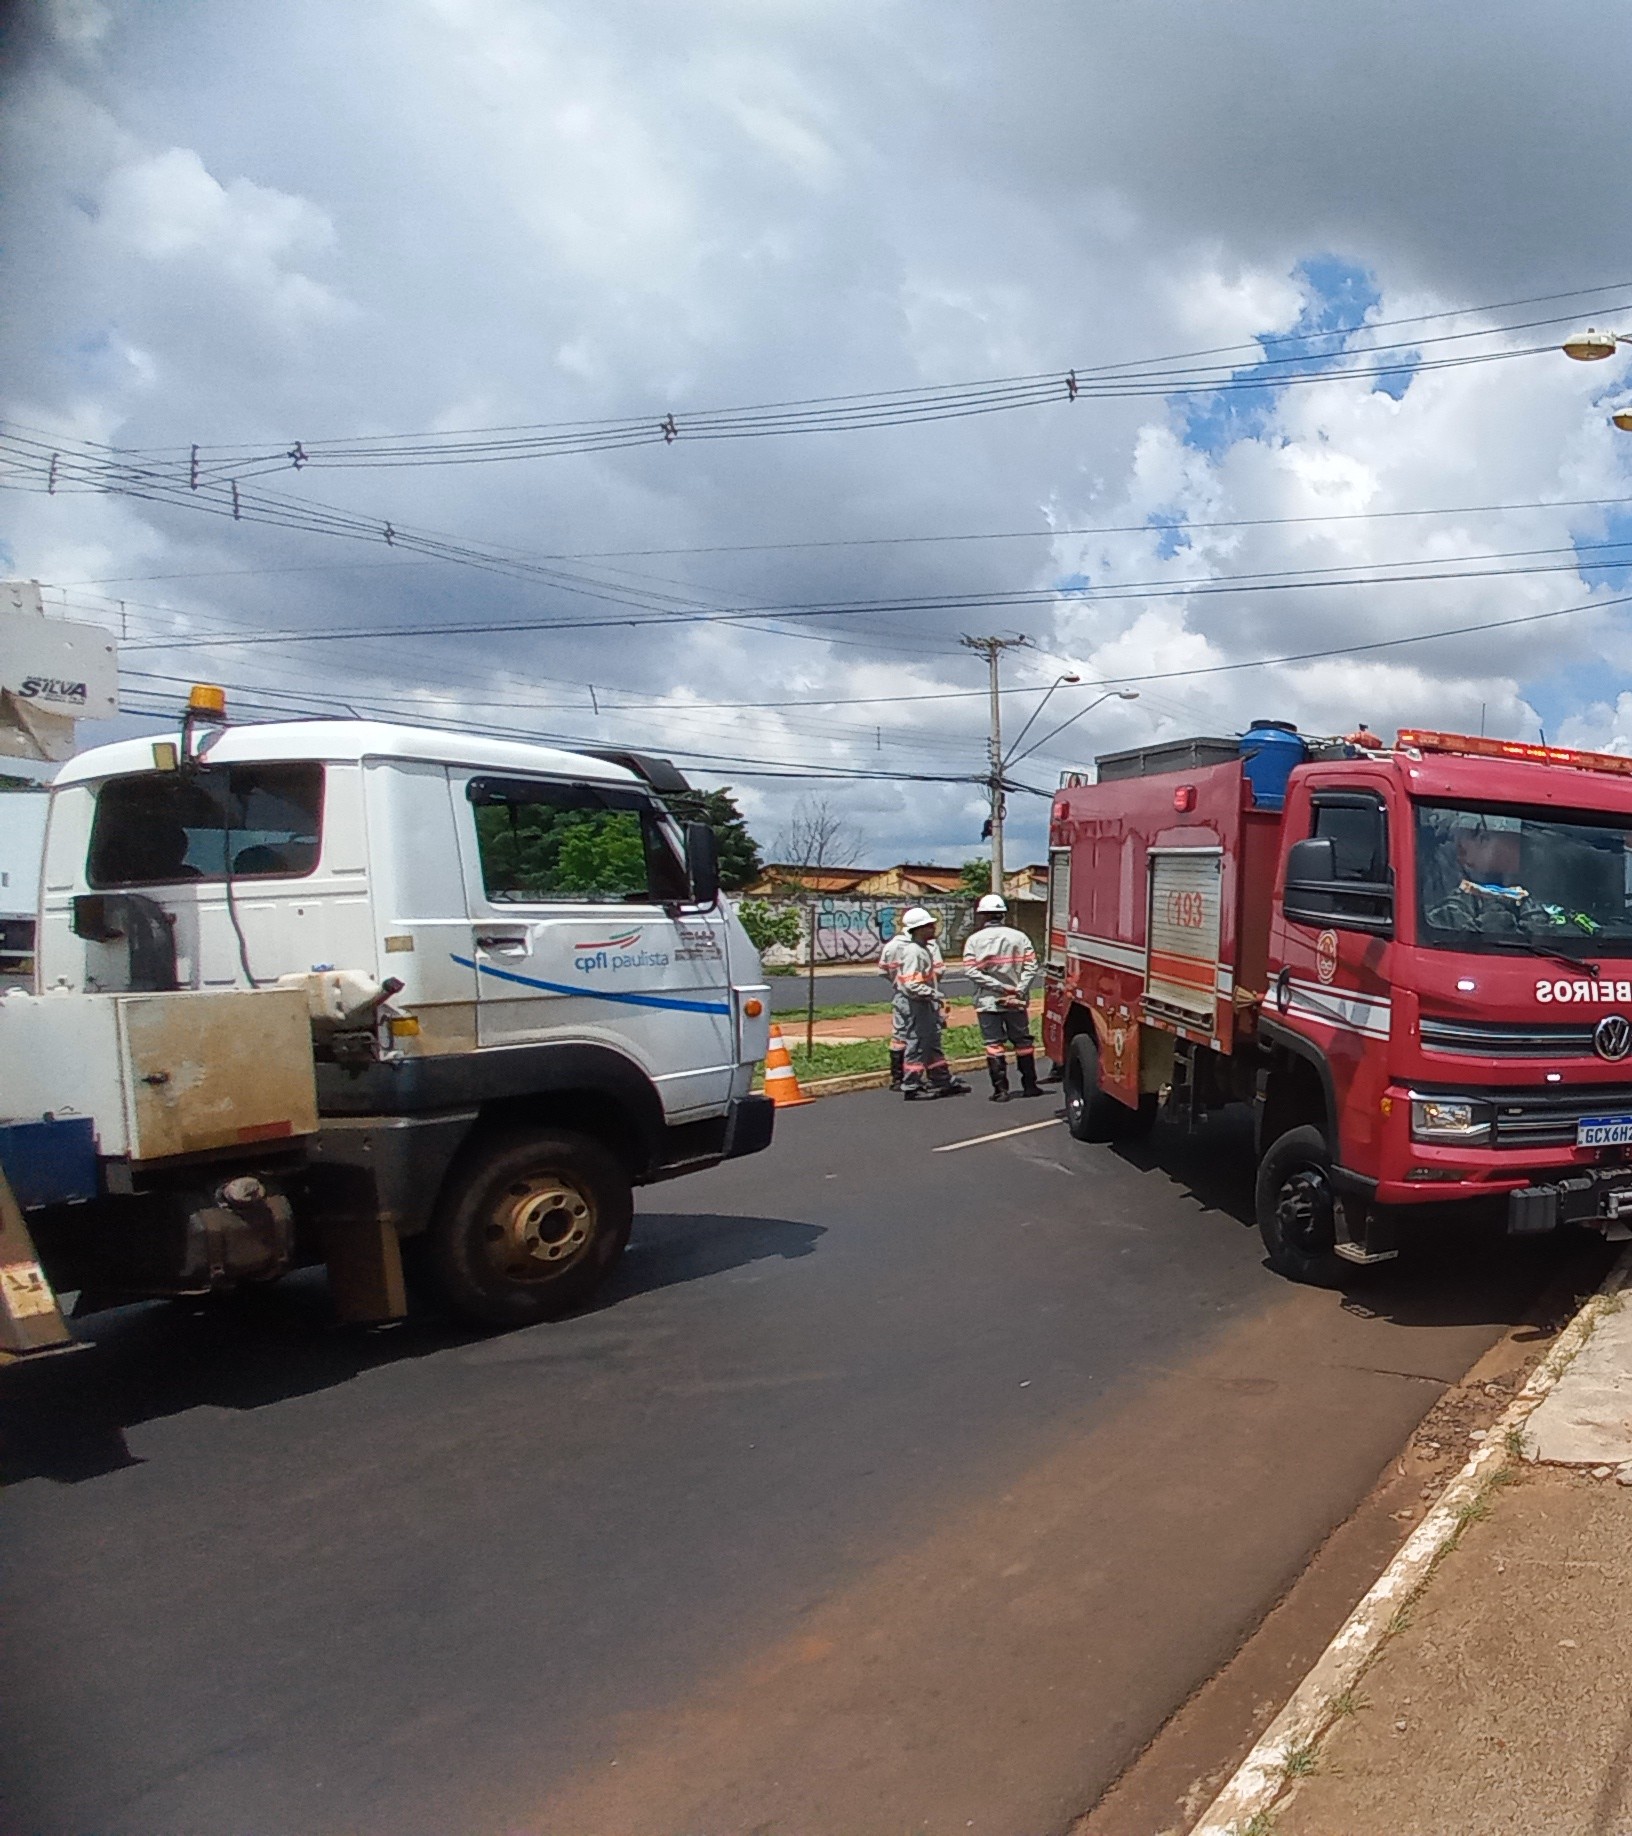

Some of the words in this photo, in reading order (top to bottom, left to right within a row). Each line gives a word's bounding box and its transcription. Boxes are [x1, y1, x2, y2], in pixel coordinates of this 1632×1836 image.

[19, 680, 87, 699] SILVA
[575, 952, 607, 973] cpfl
[612, 950, 669, 972] paulista
